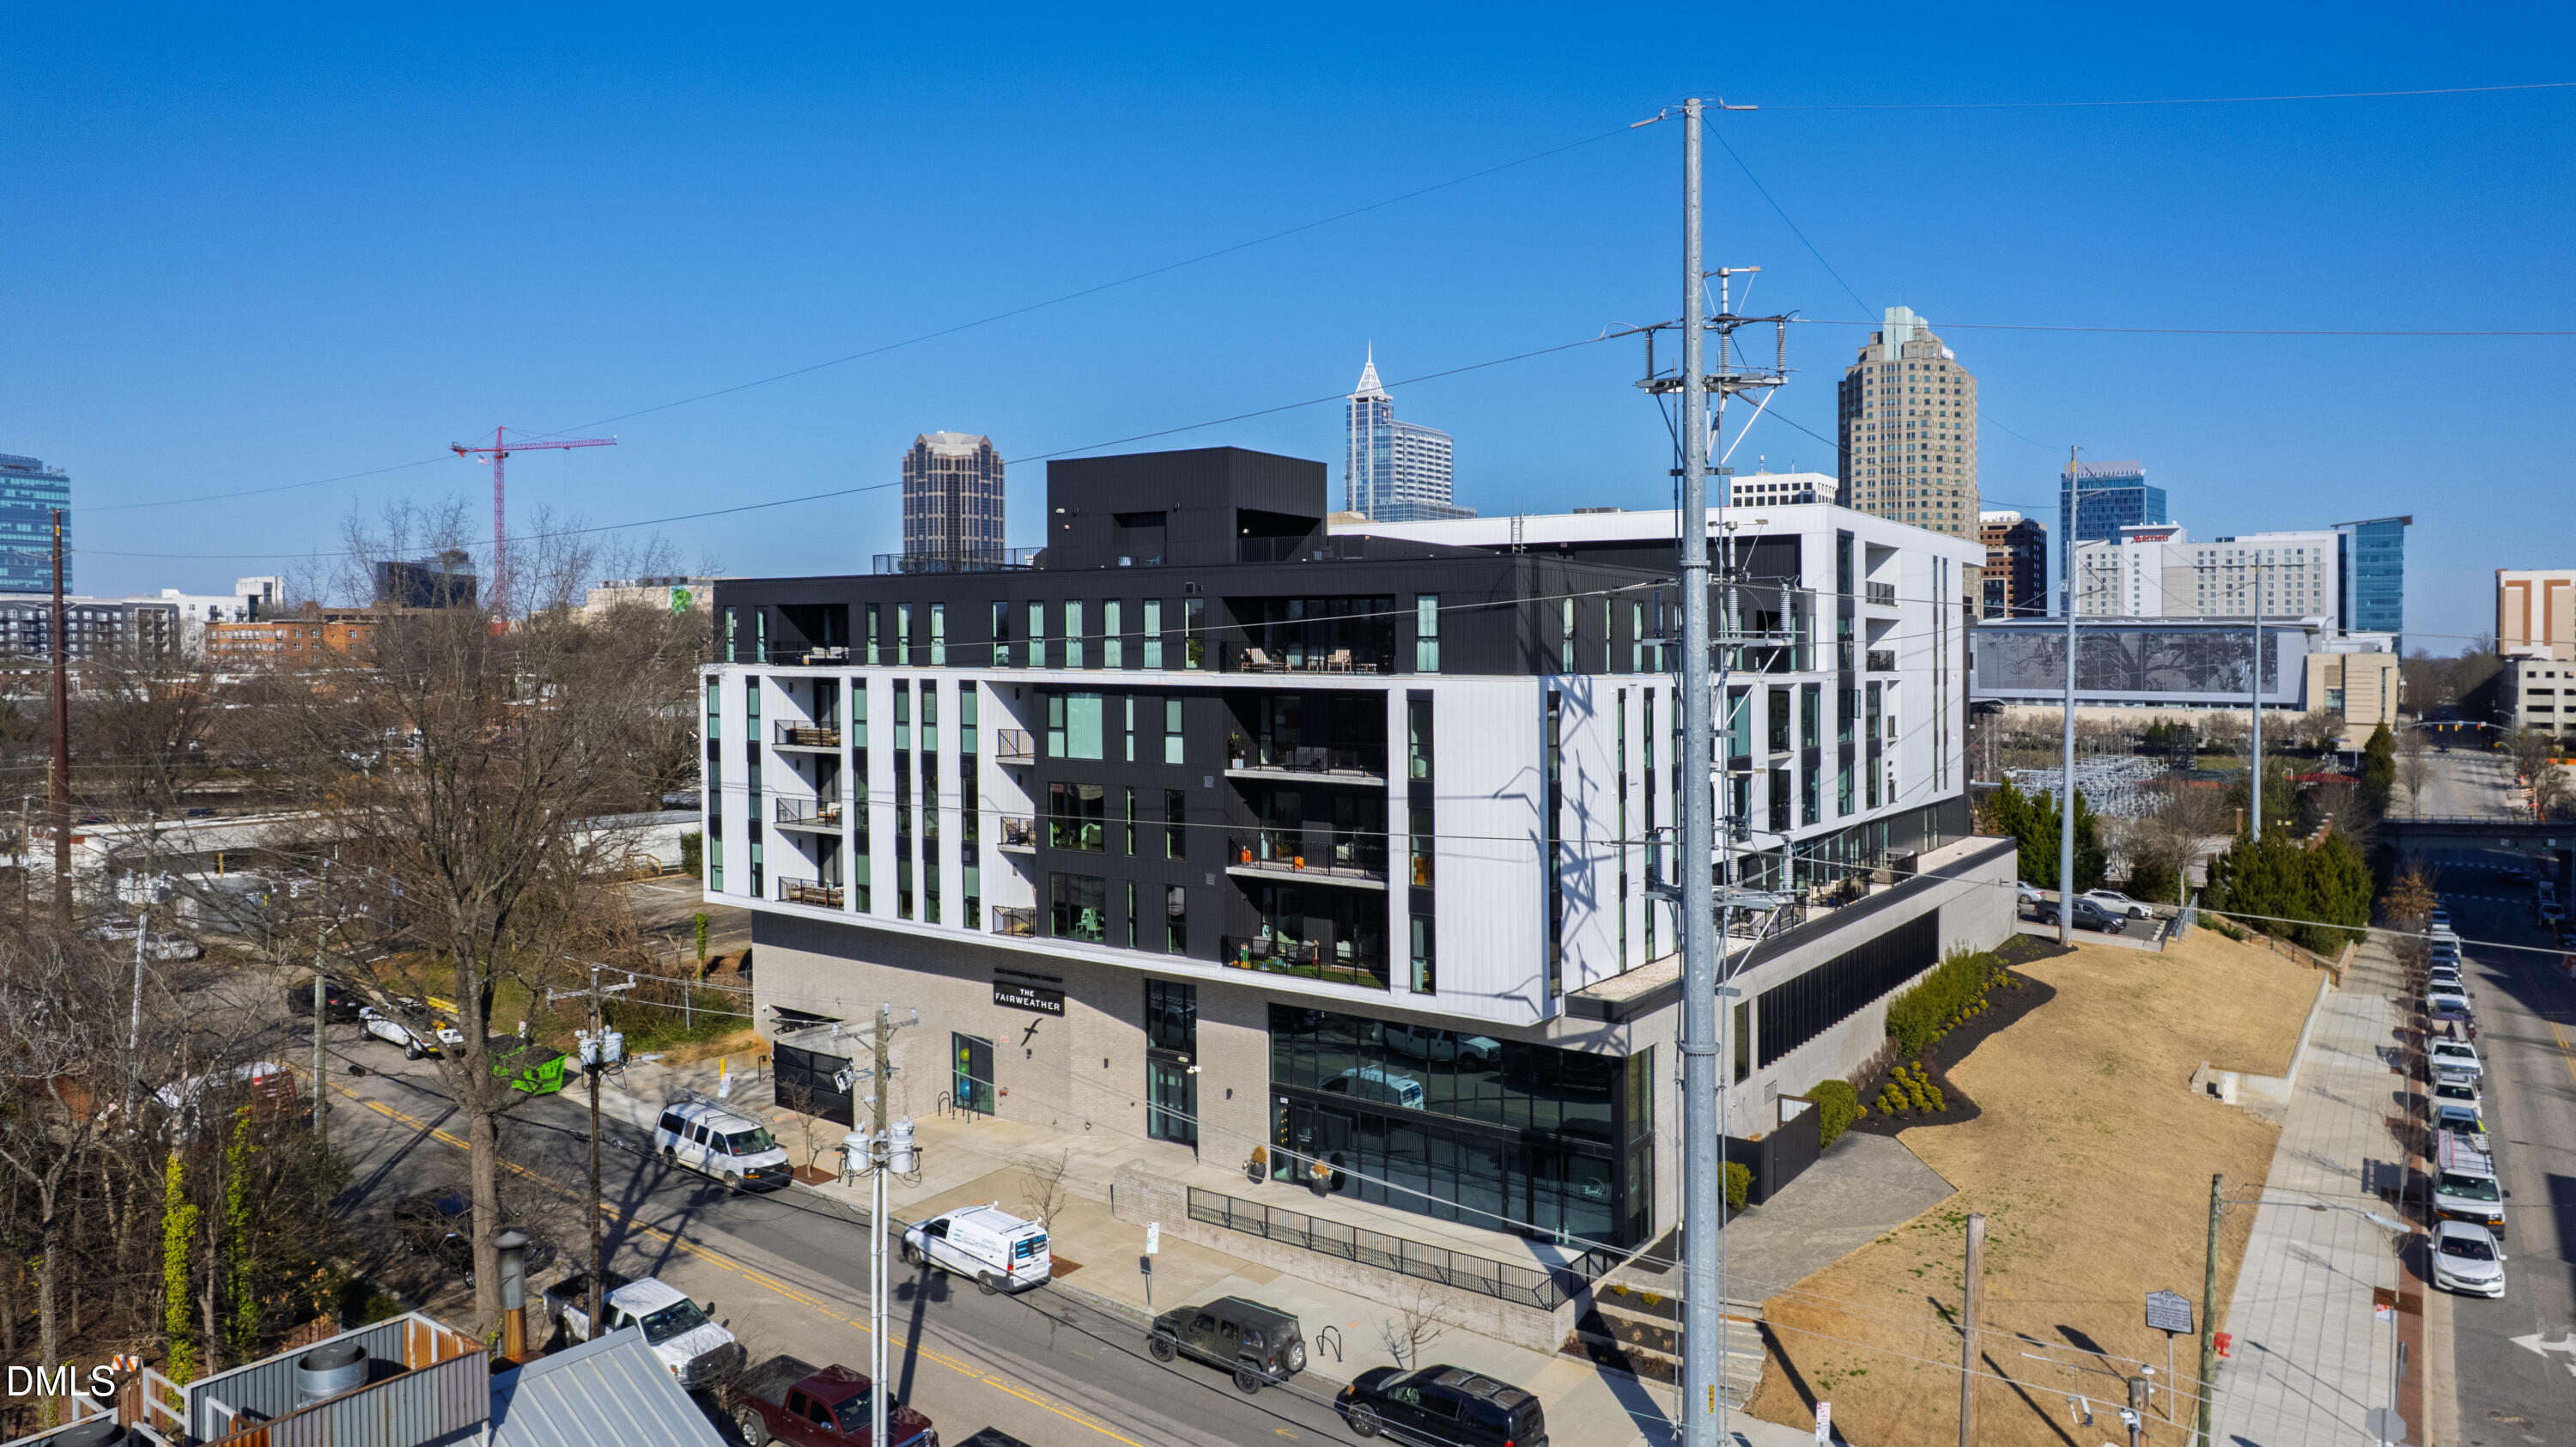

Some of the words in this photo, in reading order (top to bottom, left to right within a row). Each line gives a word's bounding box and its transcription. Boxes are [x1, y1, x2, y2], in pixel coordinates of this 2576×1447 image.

[2130, 534, 2169, 544] Marriott
[1019, 988, 1035, 997] THE
[995, 993, 1060, 1012] FAIRWEATHER
